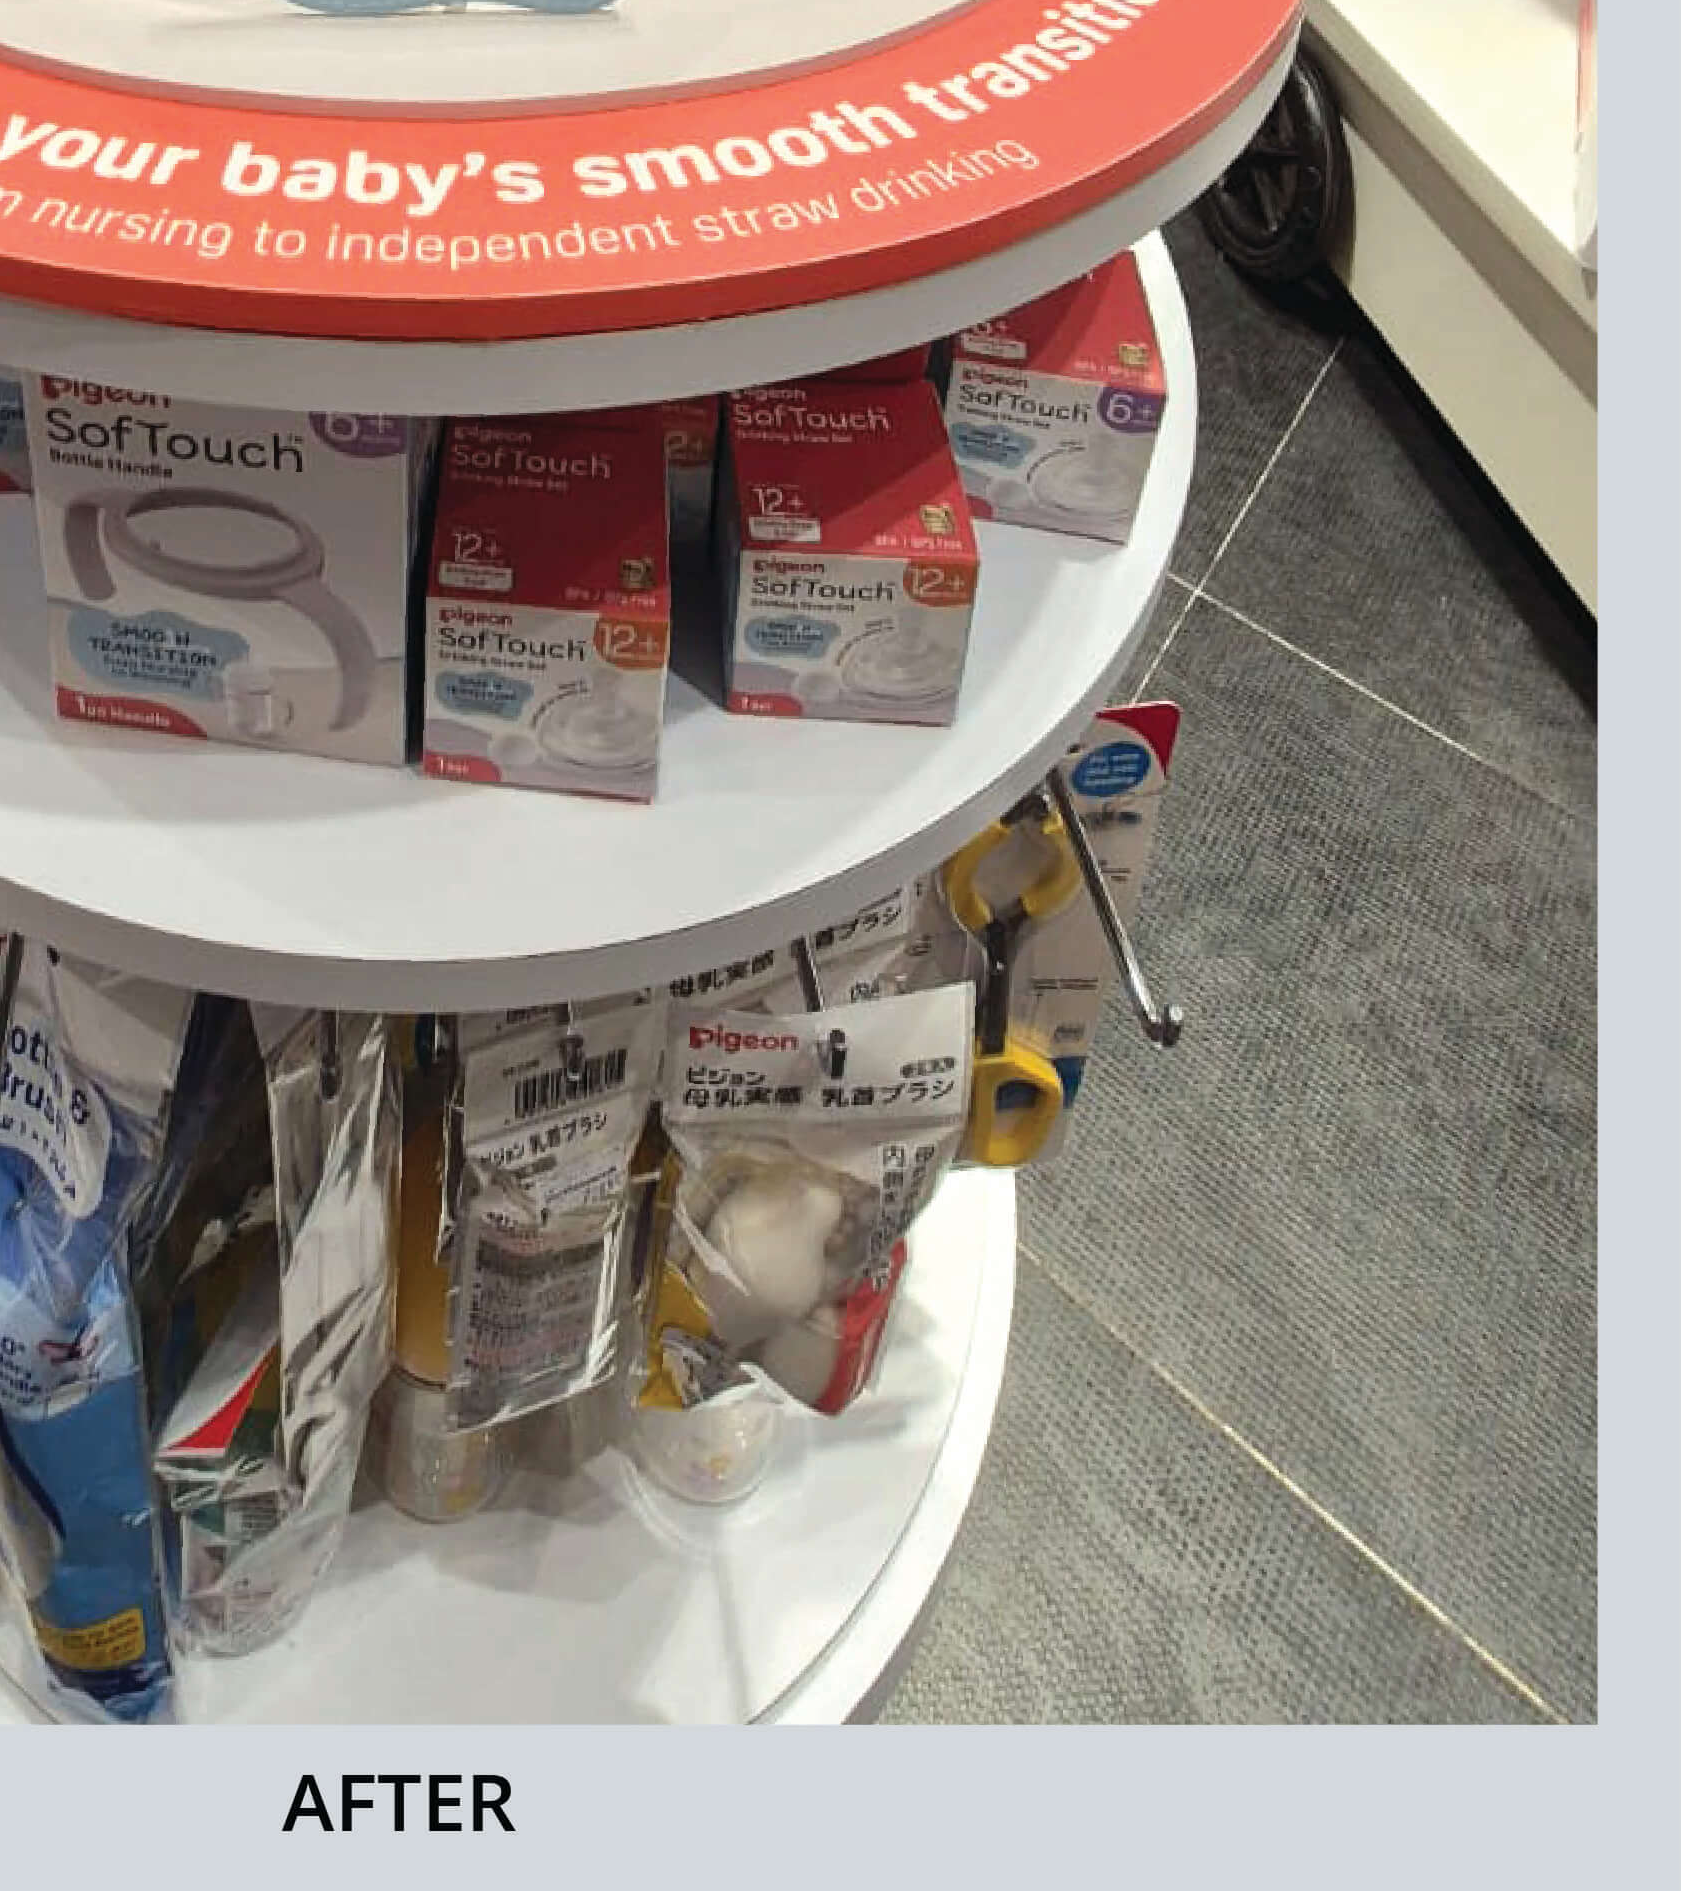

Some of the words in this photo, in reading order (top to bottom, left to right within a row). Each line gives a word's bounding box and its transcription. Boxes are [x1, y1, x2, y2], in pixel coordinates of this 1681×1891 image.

[221, 140, 547, 218] baby's
[579, 98, 916, 202] smooth
[30, 194, 233, 260] nursing
[253, 221, 307, 259] to
[325, 212, 681, 273] independent
[697, 186, 841, 244] straw
[848, 134, 1040, 215] drinking
[41, 374, 172, 409] pigeon
[1106, 392, 1152, 423] 6+
[49, 448, 103, 470] Bottle
[107, 458, 174, 480] Handle
[751, 488, 806, 516] 12+
[452, 531, 505, 563] 12+
[753, 556, 826, 574] pigeon
[910, 567, 965, 599] 12+
[438, 607, 513, 628] pigeon
[87, 636, 217, 667] TRANSITION
[598, 621, 662, 660] 12+
[815, 904, 903, 949] 首ブラシ
[687, 1025, 800, 1053] pigeon
[686, 1066, 766, 1086] ピジョン
[821, 1079, 955, 1108] 乳首ブラシ
